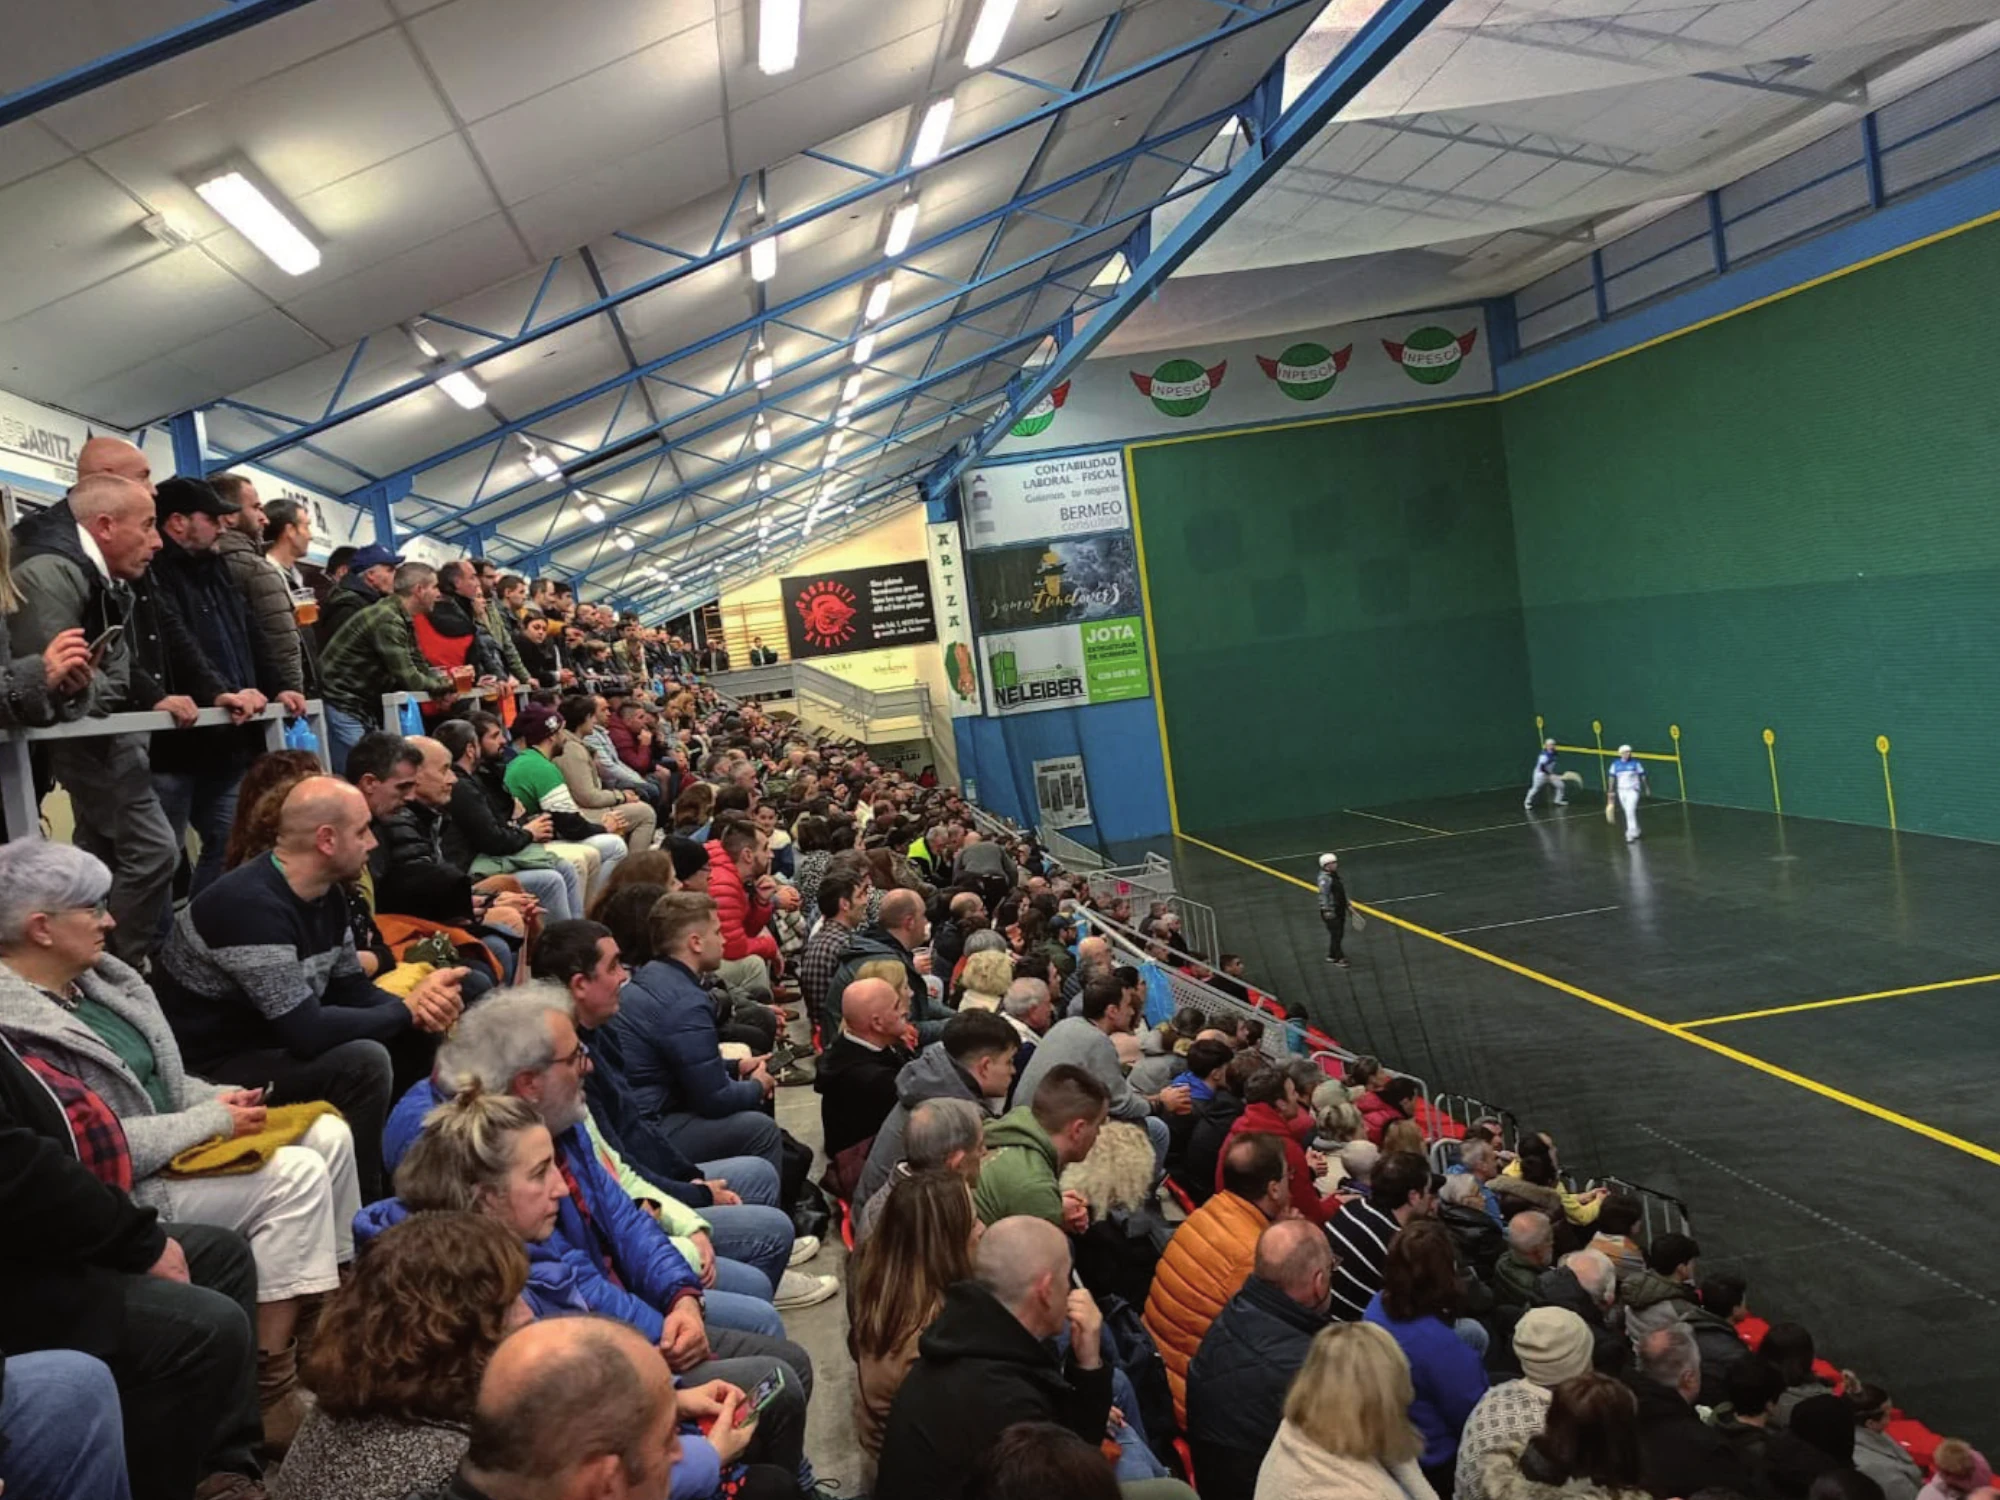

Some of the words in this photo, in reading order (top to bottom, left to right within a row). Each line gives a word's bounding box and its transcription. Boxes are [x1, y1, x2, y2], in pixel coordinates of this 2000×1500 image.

[1402, 346, 1459, 364] INPESCA
[1277, 363, 1337, 380] INPESCA
[1151, 379, 1210, 397] INPESCA
[1035, 456, 1116, 476] CONTABILIDAD
[1023, 475, 1073, 489] LABORAL
[1082, 468, 1119, 482] FISCAL
[1060, 501, 1122, 521] BERMEO
[937, 533, 960, 628] ARTZA
[1086, 624, 1136, 643] JOTA
[995, 678, 1084, 705] NELEIBER
